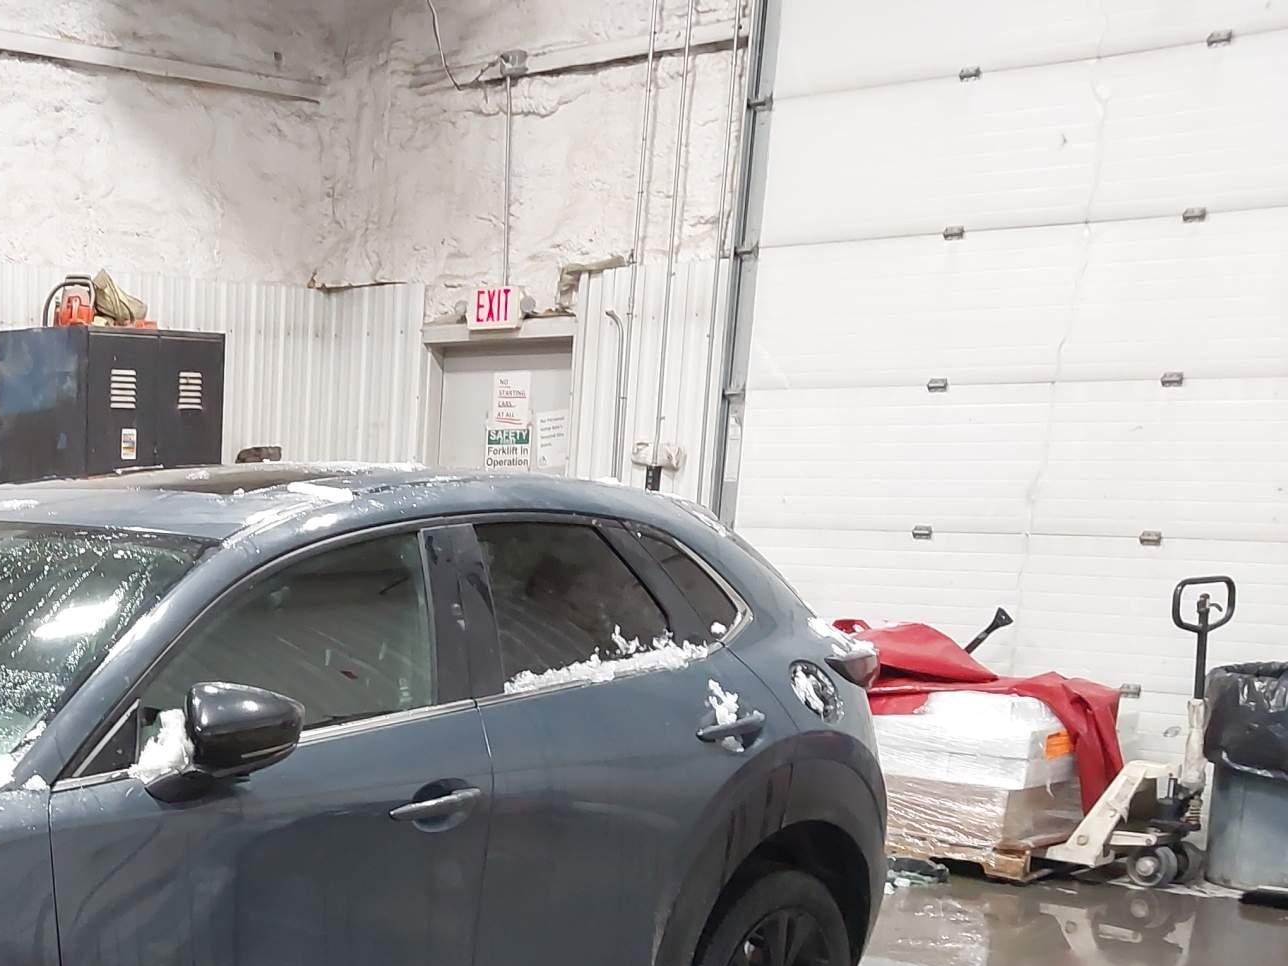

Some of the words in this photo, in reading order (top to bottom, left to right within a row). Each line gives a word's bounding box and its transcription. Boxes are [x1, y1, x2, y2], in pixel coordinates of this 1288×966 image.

[476, 289, 511, 322] EXIT
[489, 429, 528, 440] SAFETY
[488, 446, 518, 456] Forklift
[521, 446, 529, 455] In
[486, 457, 529, 469] Operation
